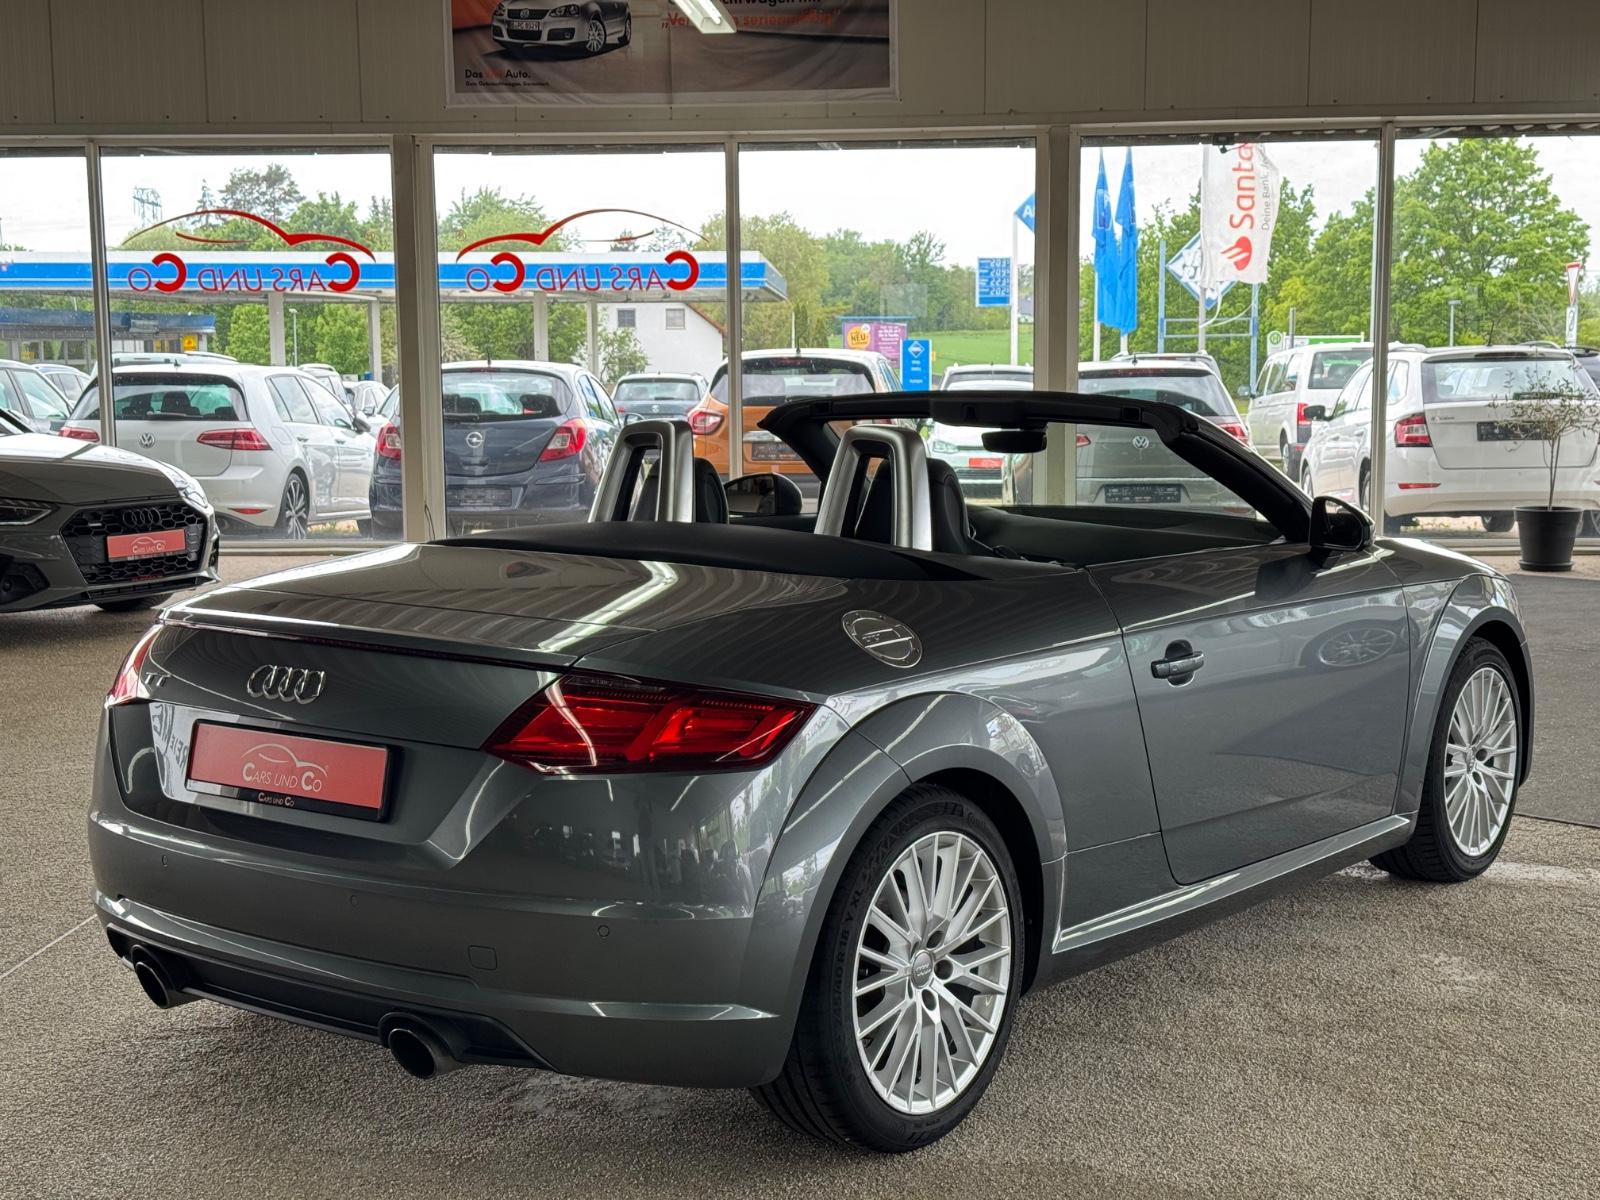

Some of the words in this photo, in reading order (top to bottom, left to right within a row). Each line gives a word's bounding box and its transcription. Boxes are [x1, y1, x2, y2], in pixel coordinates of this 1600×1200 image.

[465, 69, 484, 79] Das
[505, 68, 531, 79] Auto.
[274, 770, 298, 788] UND
